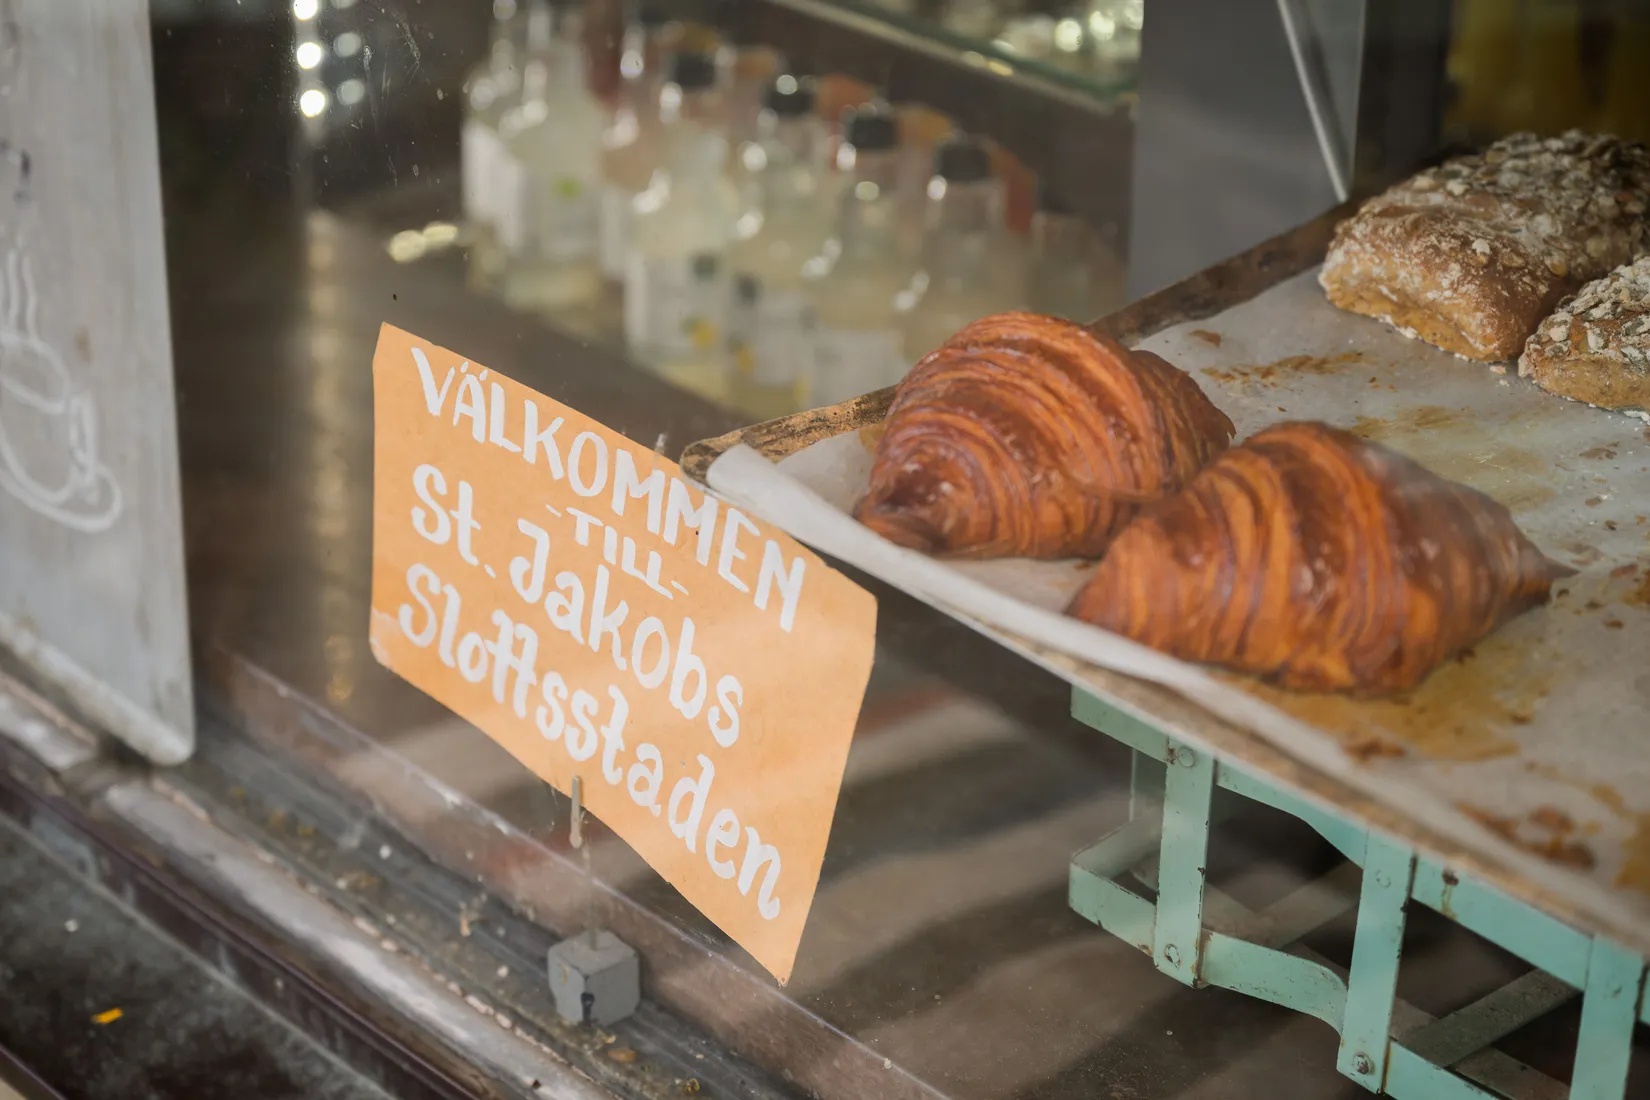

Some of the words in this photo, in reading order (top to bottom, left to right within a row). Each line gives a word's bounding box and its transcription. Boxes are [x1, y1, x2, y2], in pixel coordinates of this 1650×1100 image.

[411, 346, 806, 633] VÄLKOMMEN
[411, 463, 496, 578] St.
[509, 517, 744, 748] Jakobs
[399, 562, 782, 920] Slottsstaden
